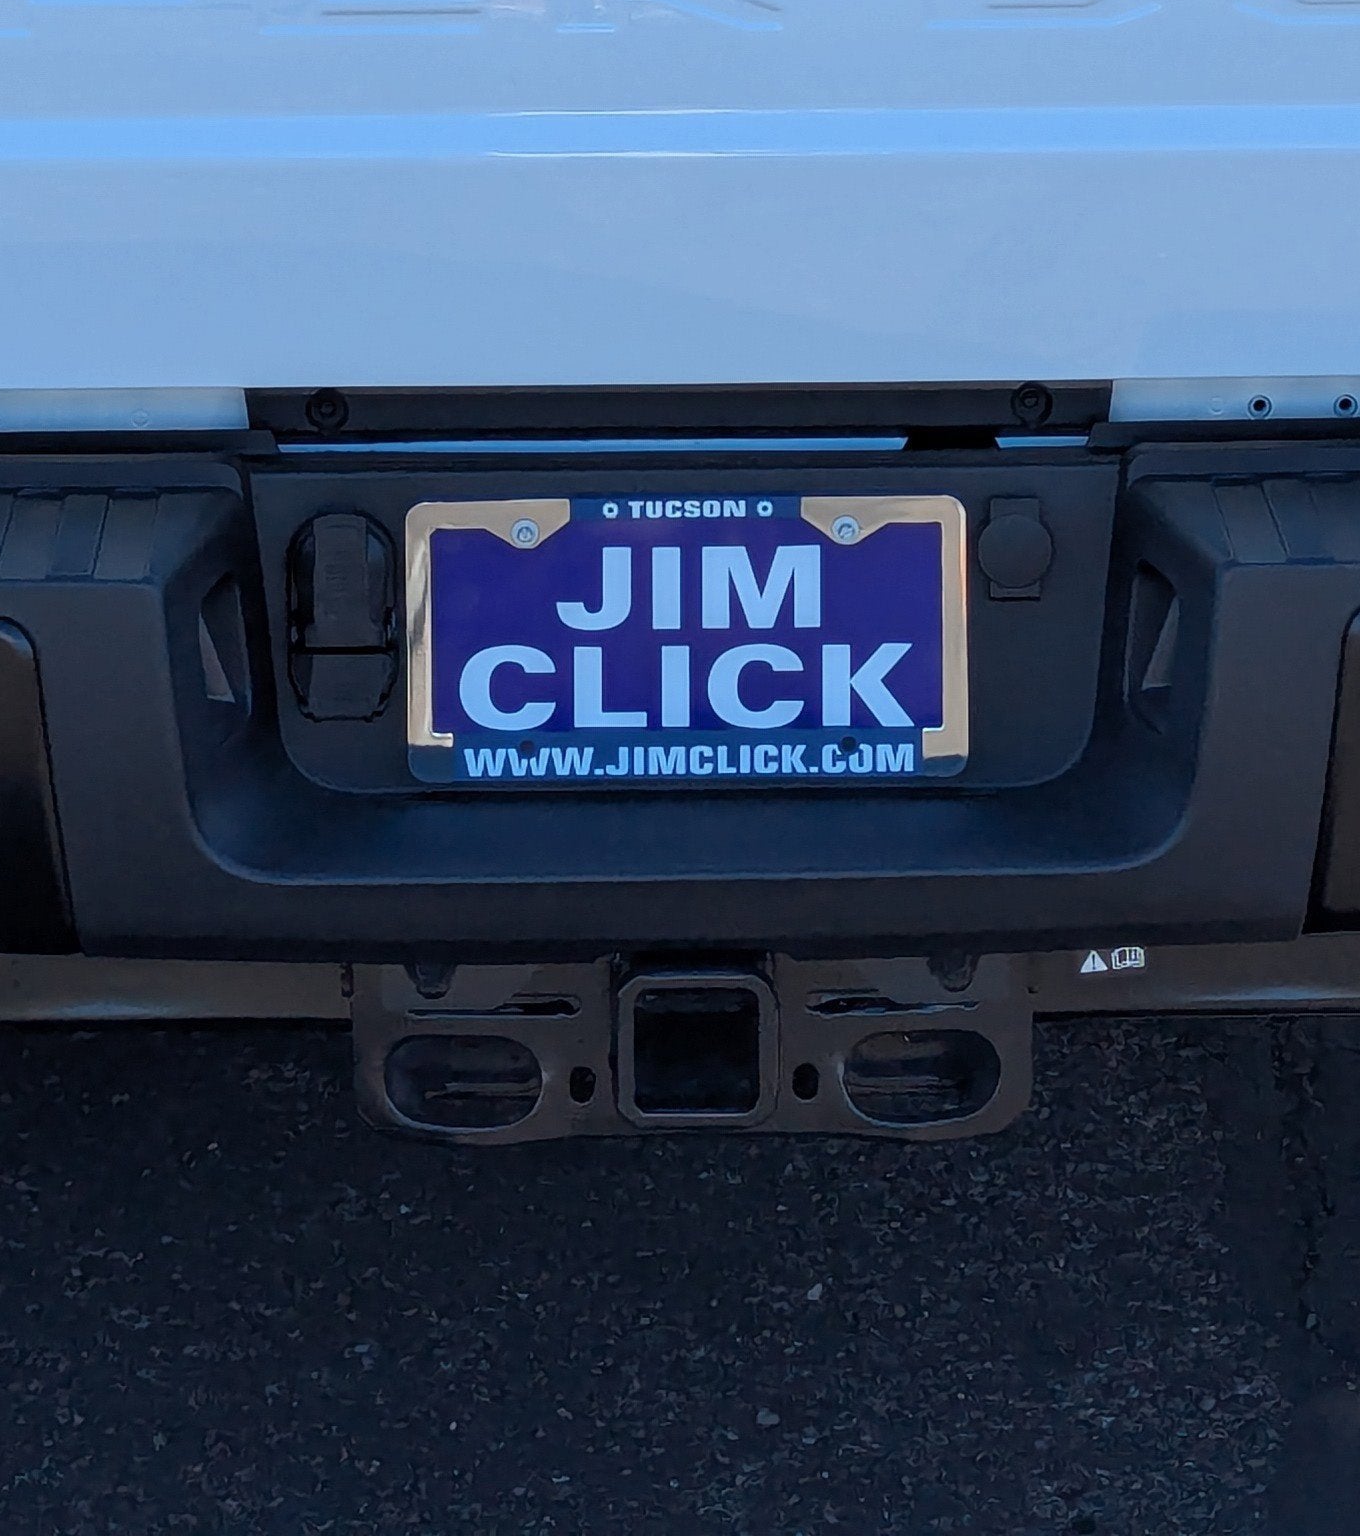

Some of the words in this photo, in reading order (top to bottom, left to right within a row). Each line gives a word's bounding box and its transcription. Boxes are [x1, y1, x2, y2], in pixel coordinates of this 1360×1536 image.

[627, 499, 747, 519] TUCSON
[555, 544, 822, 632] JIM
[457, 642, 916, 731] CLICK
[463, 743, 915, 777] WWW.JIMCLICK.COM
